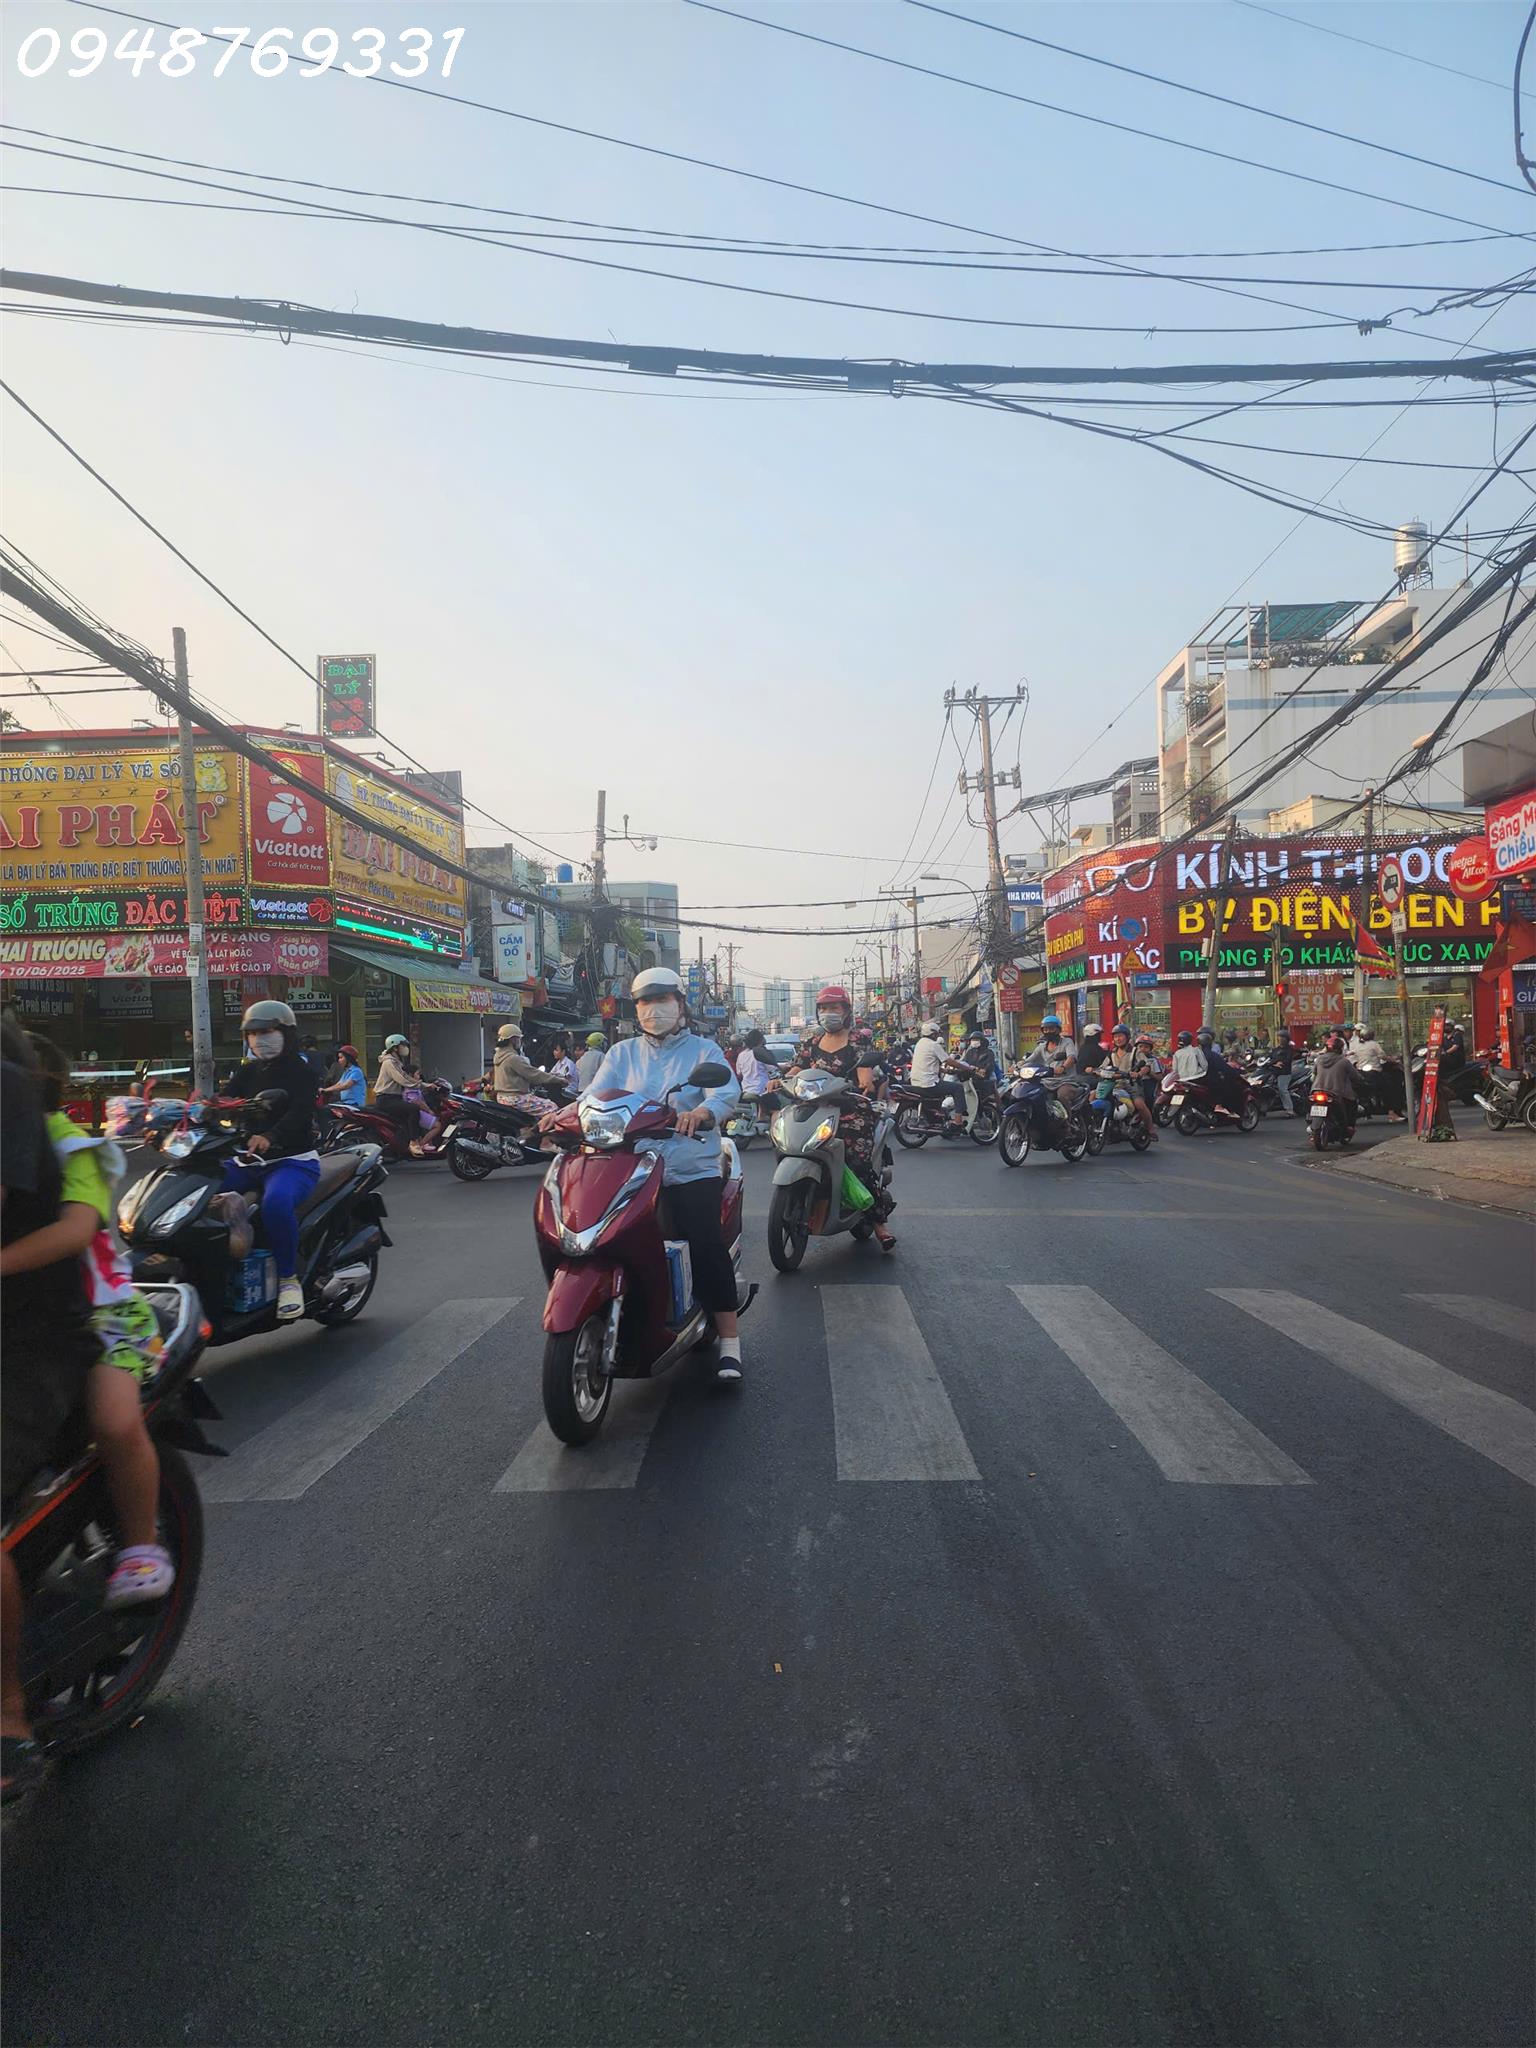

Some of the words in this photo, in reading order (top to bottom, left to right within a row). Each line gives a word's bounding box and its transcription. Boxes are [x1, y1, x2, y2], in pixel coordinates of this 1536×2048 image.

[63, 765, 96, 784] ĐẠI
[101, 760, 124, 780] LÝ
[1491, 818, 1520, 845] Sáng
[254, 838, 324, 860] Vietlott
[1499, 830, 1536, 867] Chiều
[1177, 844, 1289, 890] KÍNH
[251, 898, 309, 914] Vietlott
[1020, 891, 1042, 901] KHOA
[0, 895, 27, 928] SỐ
[34, 896, 119, 927] TRÚNG
[126, 894, 177, 928] ĐẶC
[1250, 888, 1350, 939] ĐIỆN
[153, 934, 185, 945] MUA
[279, 943, 319, 957] 1000
[262, 962, 272, 973] TP
[1285, 994, 1340, 1013] 259K
